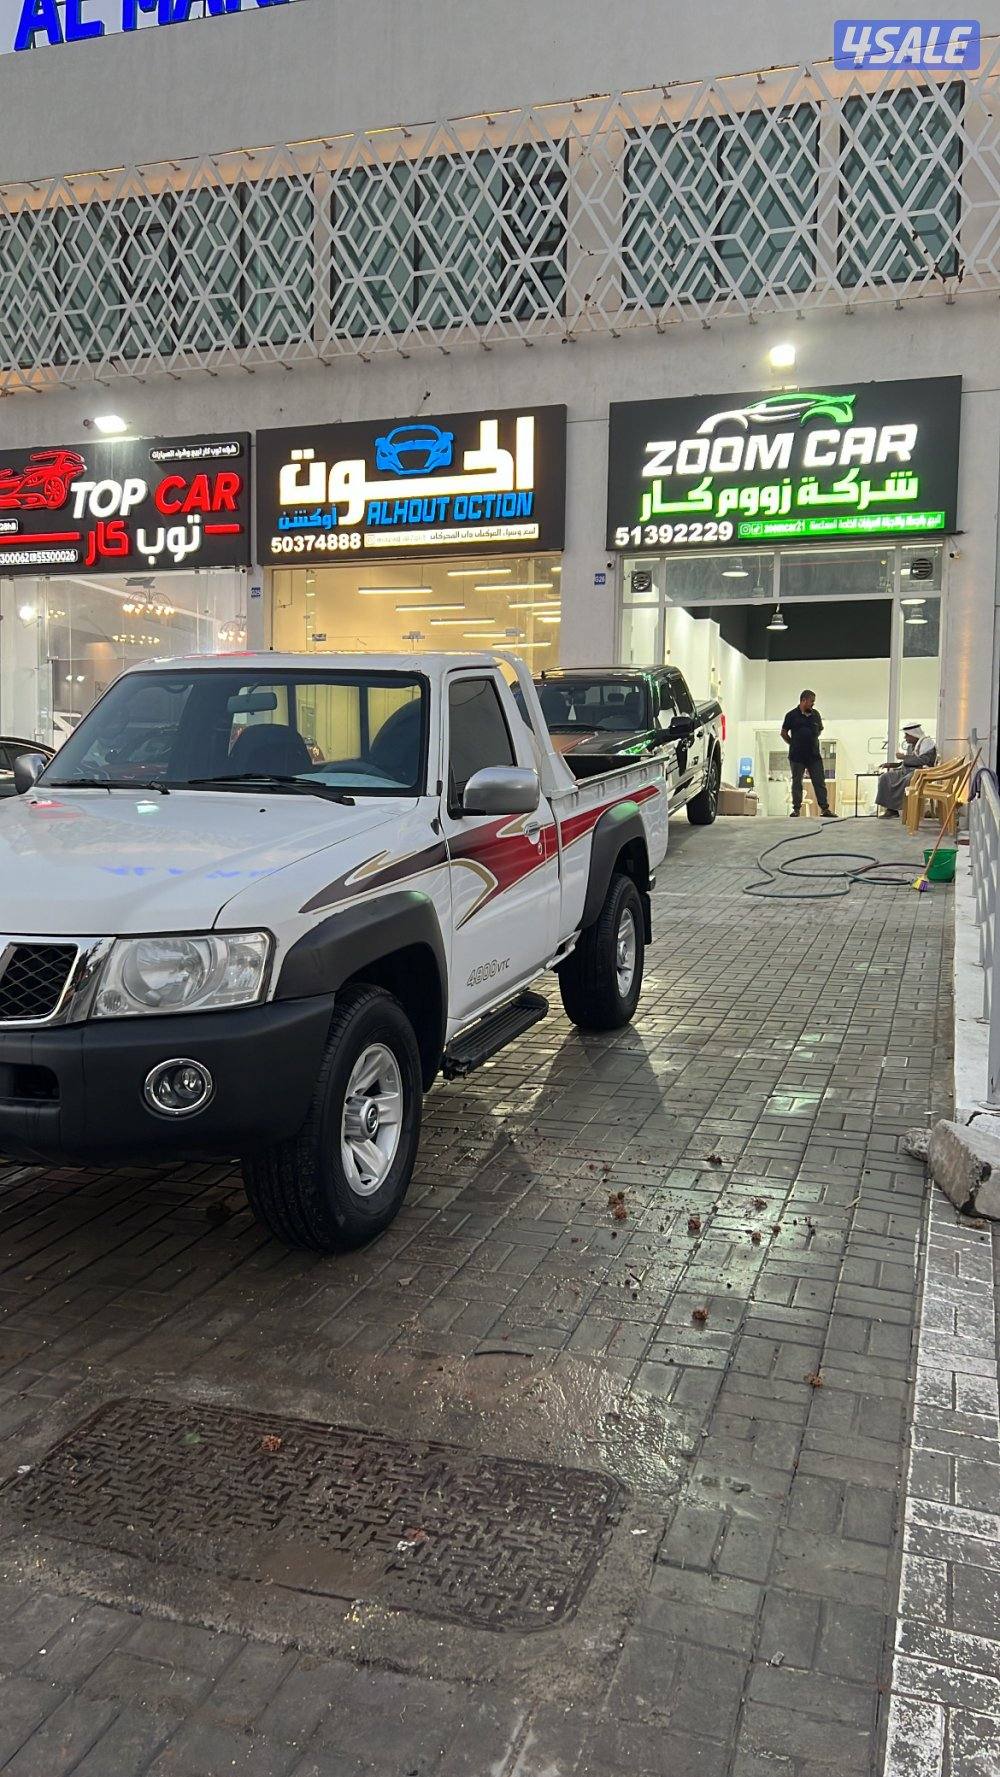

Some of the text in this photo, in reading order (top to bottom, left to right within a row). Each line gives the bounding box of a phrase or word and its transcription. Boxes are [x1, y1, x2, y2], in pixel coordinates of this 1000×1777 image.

[279, 416, 535, 526] الحوت
[641, 423, 919, 478] ZOOM CAR
[70, 472, 241, 519] TOP CAR
[278, 503, 338, 531] أوكشن
[366, 496, 451, 526] ALHOUT
[639, 467, 920, 522] شركة زووم كار
[85, 514, 202, 567] توب كار
[270, 532, 362, 554] 50374888
[614, 521, 734, 547] 51392229
